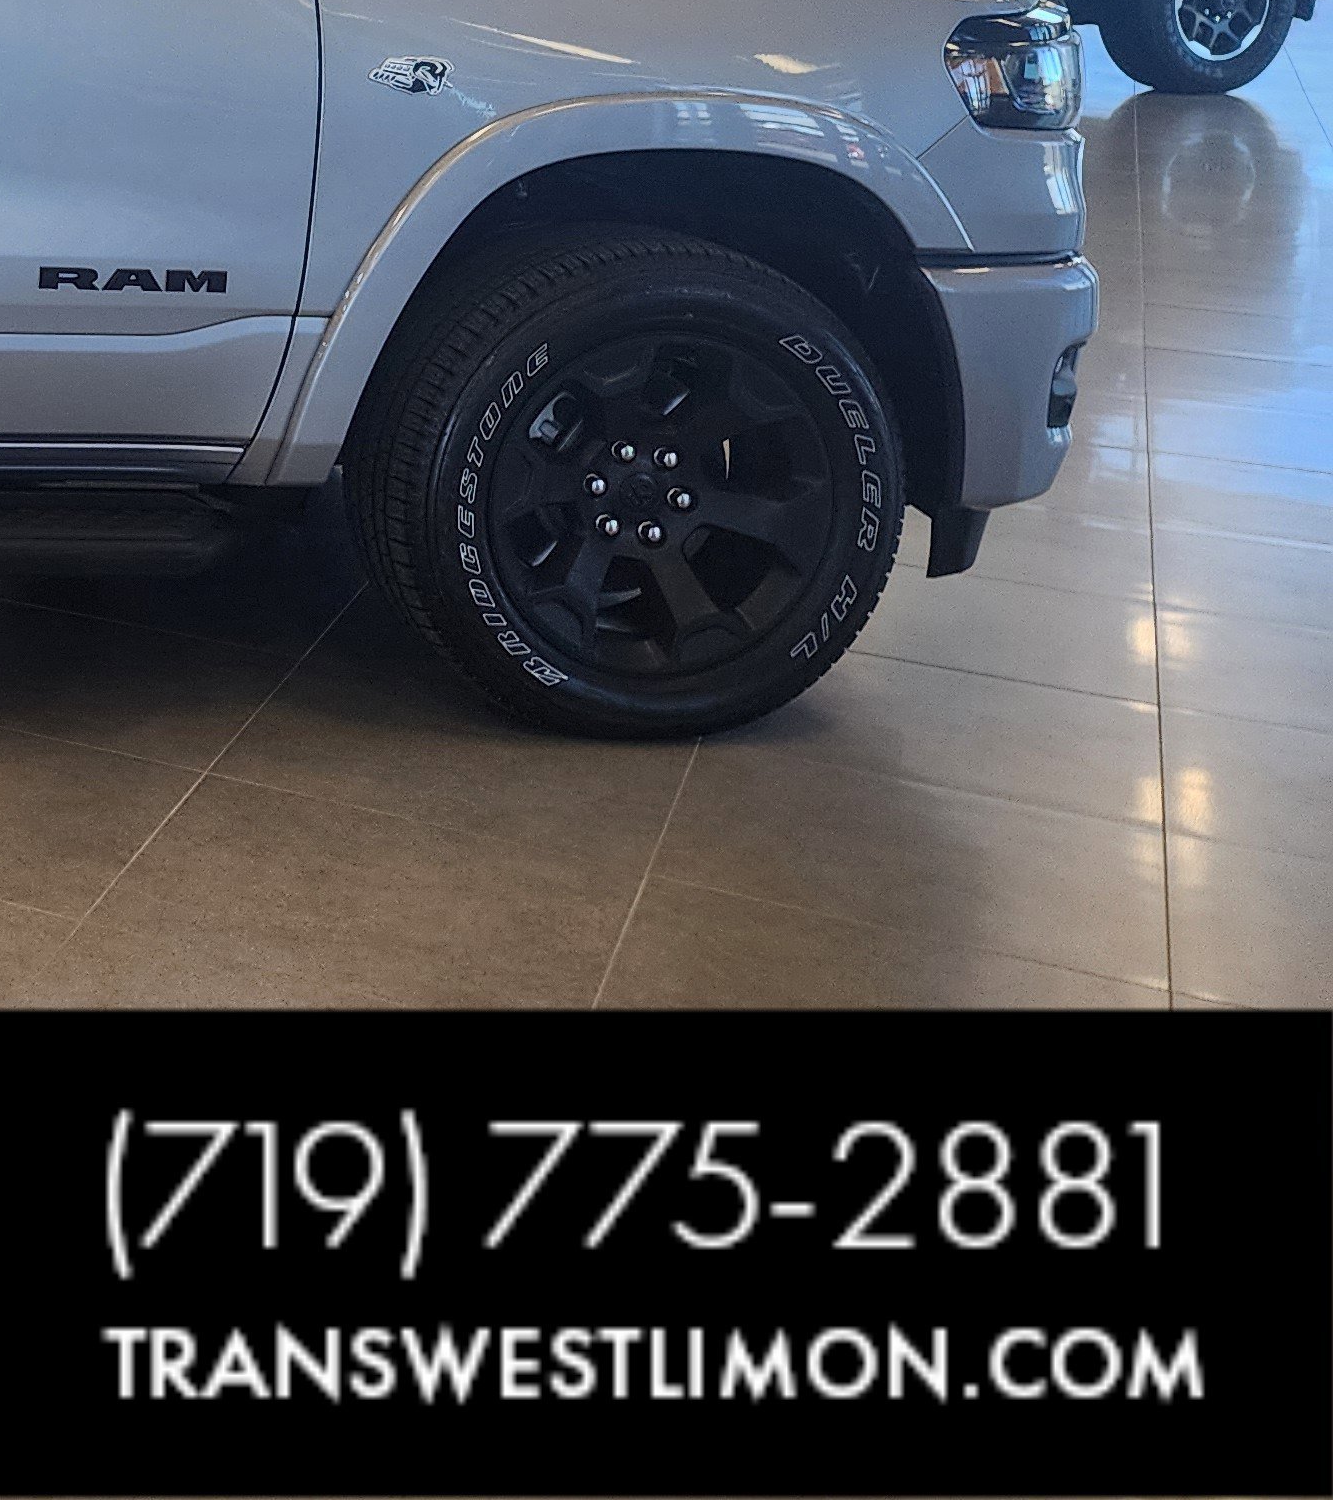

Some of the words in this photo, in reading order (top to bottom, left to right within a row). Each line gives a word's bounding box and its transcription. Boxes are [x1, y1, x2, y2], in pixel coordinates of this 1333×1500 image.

[38, 266, 228, 294] RAM
[455, 343, 569, 686] BRIDGESTONE
[778, 334, 883, 552] DUELER
[790, 574, 859, 659] H/L
